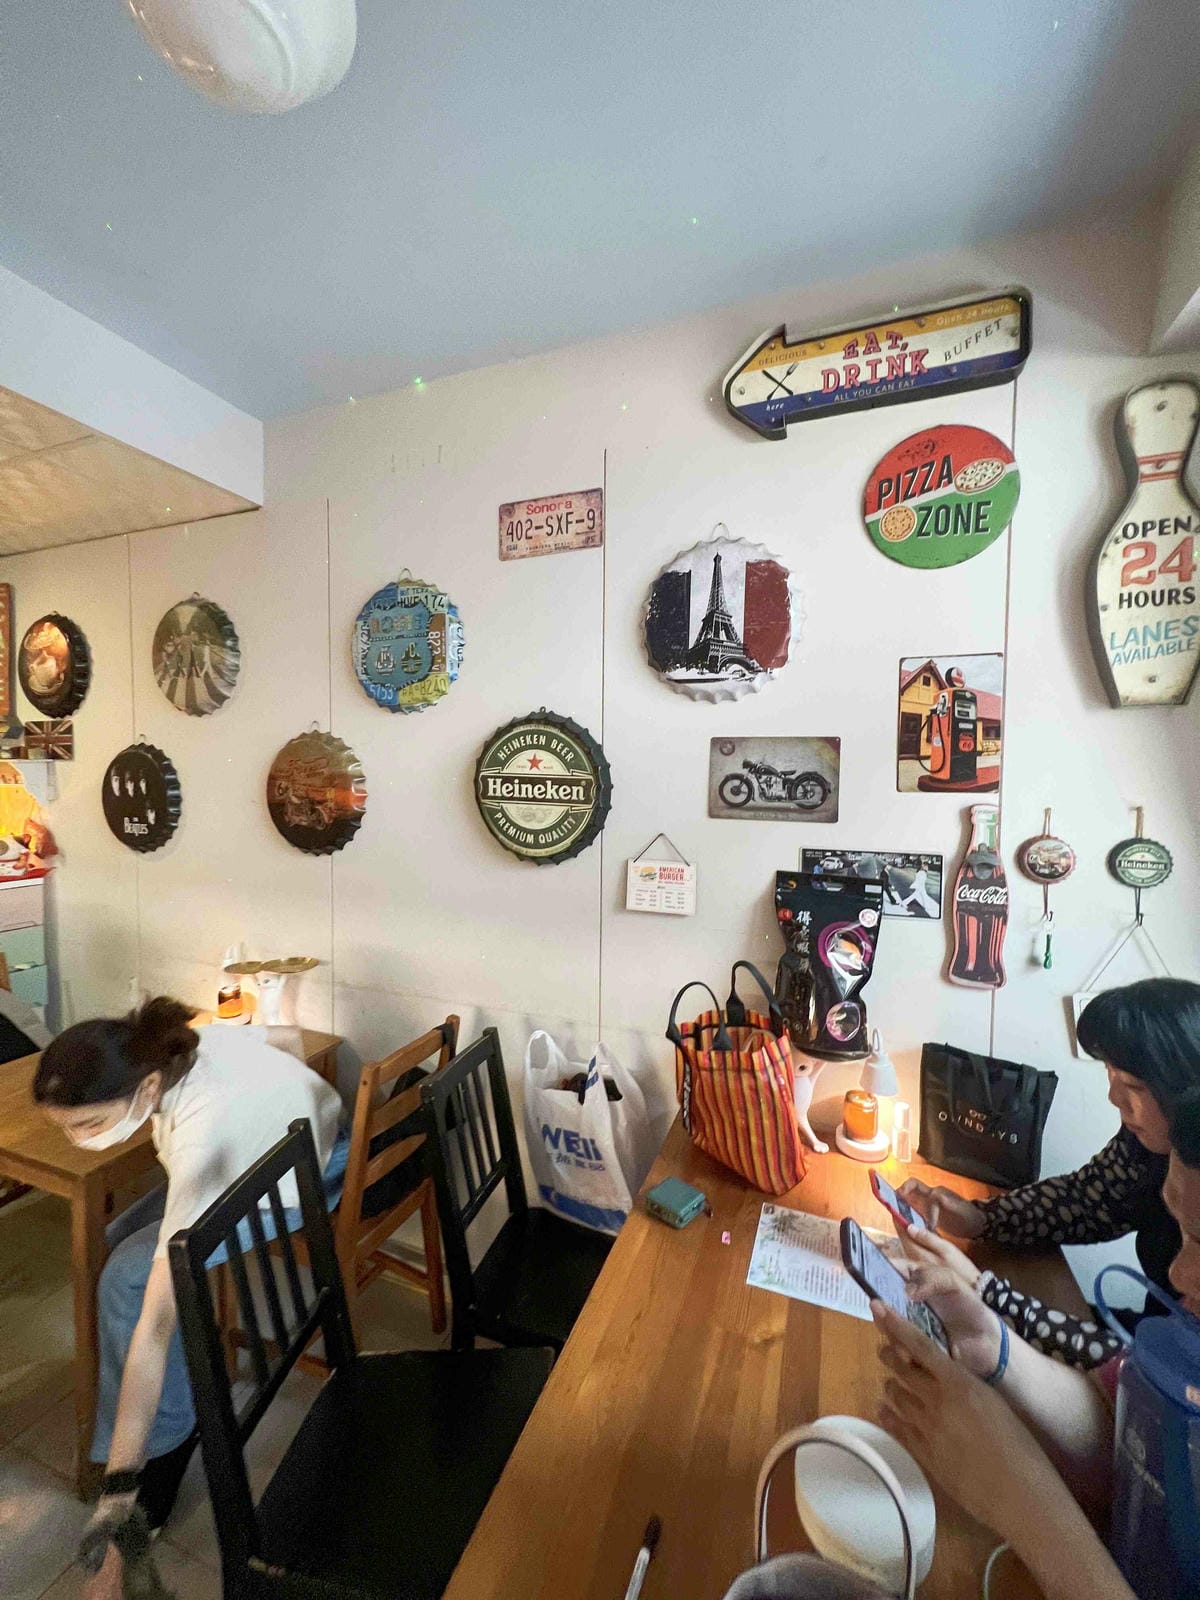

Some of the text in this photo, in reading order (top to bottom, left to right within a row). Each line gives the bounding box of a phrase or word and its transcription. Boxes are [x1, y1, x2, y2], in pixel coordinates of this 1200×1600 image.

[944, 318, 1002, 362] BUFFET
[758, 349, 808, 367] DELICIOUS
[822, 348, 929, 394] DRINK
[834, 379, 915, 403] ALL YOU CAN EAT
[765, 402, 785, 412] here
[877, 454, 955, 511] PIZZA
[526, 501, 573, 515] Sonora
[917, 500, 993, 538] ZONE
[506, 508, 596, 543] 402-SXF-9
[1121, 515, 1193, 541] OPEN
[1120, 536, 1197, 587] 24
[424, 592, 446, 609] 174
[1118, 586, 1196, 610] HOURS
[1110, 615, 1200, 651] LANES
[1111, 637, 1197, 667] AVAILABLE
[497, 734, 575, 762] HEINEKEN BEER
[487, 778, 585, 801] Heineken
[494, 812, 577, 845] PREMIUM QUALITY
[1120, 859, 1166, 870] Heineken
